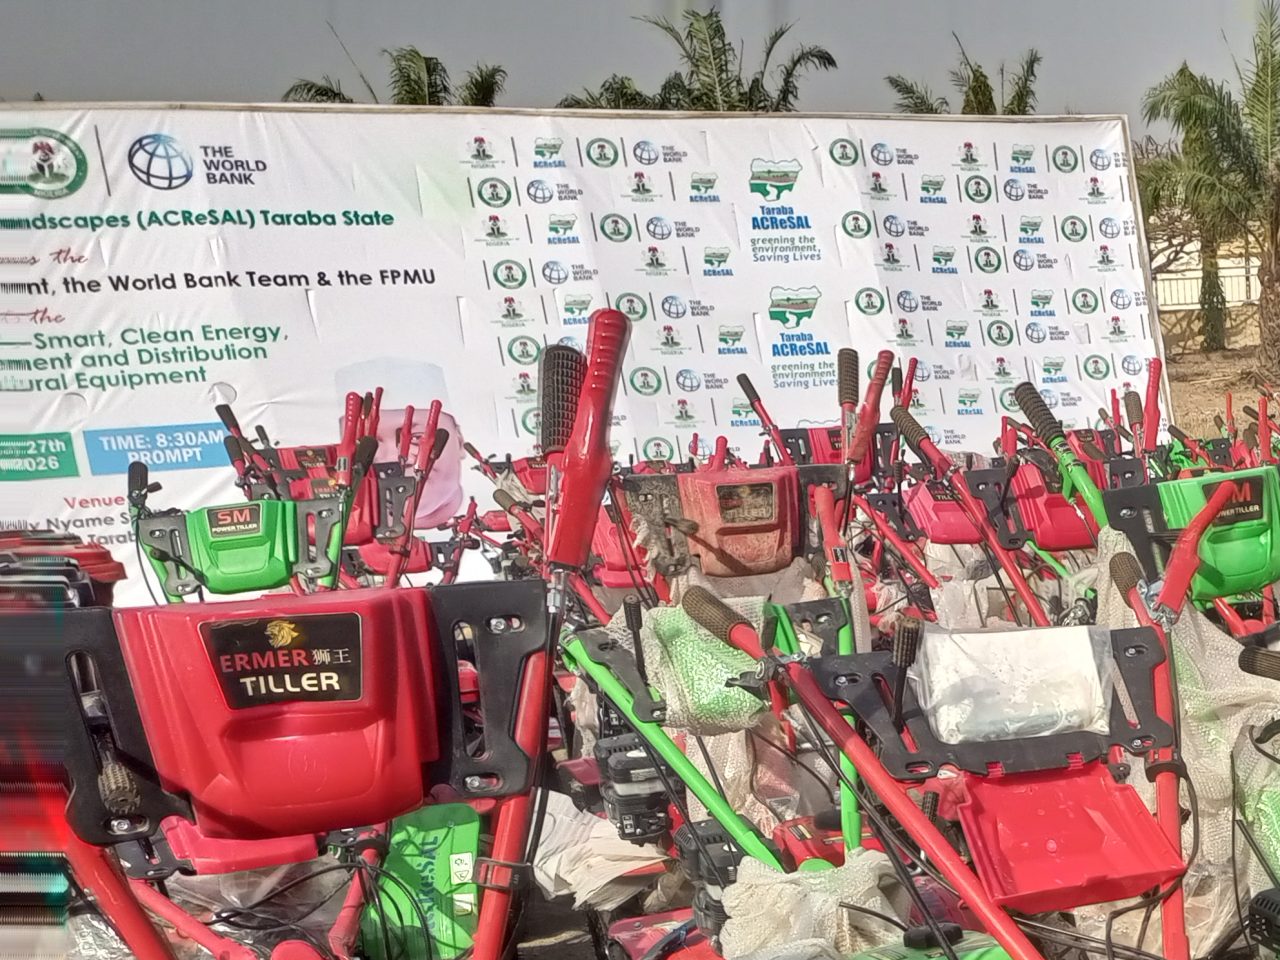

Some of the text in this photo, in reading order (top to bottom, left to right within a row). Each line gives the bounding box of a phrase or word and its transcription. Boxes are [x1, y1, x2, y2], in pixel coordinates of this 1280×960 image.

[200, 145, 234, 158] THE
[203, 159, 267, 173] WORLD
[206, 172, 255, 185] BANK
[759, 205, 794, 216] Taraba
[137, 209, 255, 231] (ACReSAL)
[260, 209, 336, 226] Taraba
[343, 210, 394, 226] State
[751, 215, 812, 230] ACReSAL
[750, 235, 816, 247] greening the
[753, 251, 821, 263] Saving Lives
[63, 276, 101, 293] the
[107, 273, 176, 291] World
[184, 271, 241, 289] Bank
[246, 271, 309, 287] Team
[317, 272, 333, 286] &
[338, 270, 373, 286] the
[380, 269, 436, 286] FPMU
[34, 325, 288, 350] Smart, Clean Energy,
[779, 333, 813, 343] Taraba
[81, 349, 129, 368] and
[137, 344, 268, 365] Distribution
[771, 342, 831, 357] ACReSAL
[771, 361, 836, 373] greening the
[76, 366, 207, 392] Equipment
[774, 380, 811, 390] Saving
[27, 439, 67, 455] 27th
[99, 429, 225, 451] TIME: 8:30AM
[127, 447, 202, 466] PROMPT
[64, 496, 126, 509] Venue
[1235, 504, 1260, 513] TILLER
[46, 513, 115, 531] Nyame
[217, 508, 251, 525] SM
[212, 523, 258, 533] POWER TILLER
[220, 649, 310, 673] ERMER
[312, 648, 351, 665] 狮王
[240, 672, 341, 697] TILLER
